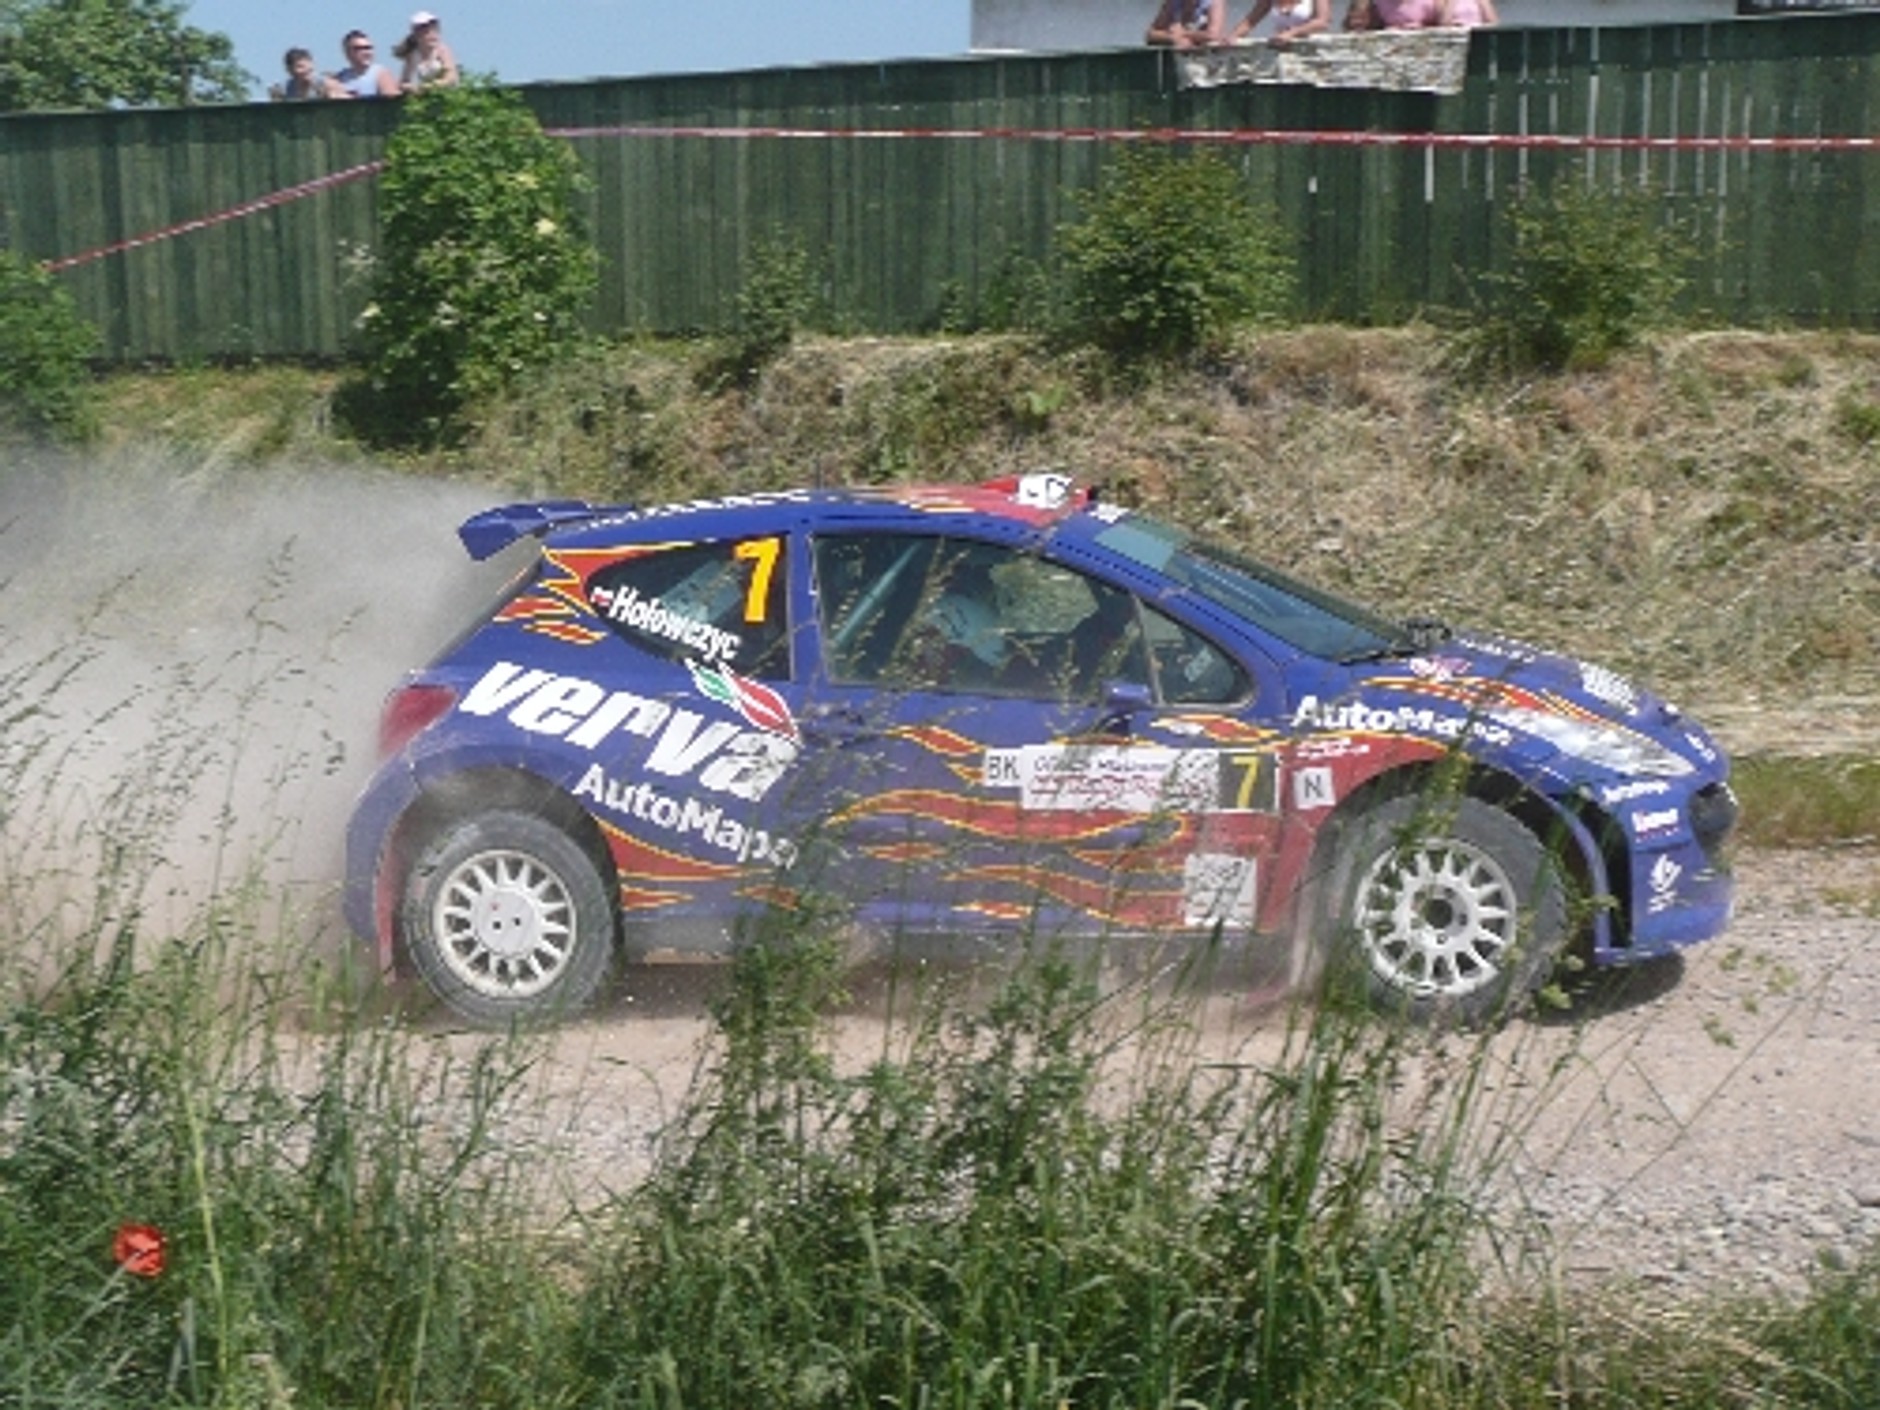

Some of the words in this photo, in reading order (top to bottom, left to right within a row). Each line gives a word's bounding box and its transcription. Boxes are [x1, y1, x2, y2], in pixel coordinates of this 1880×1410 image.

[458, 661, 799, 801] verva
[572, 763, 799, 871] AutoMapa
[1231, 755, 1260, 808] 7
[1304, 774, 1323, 798] N
